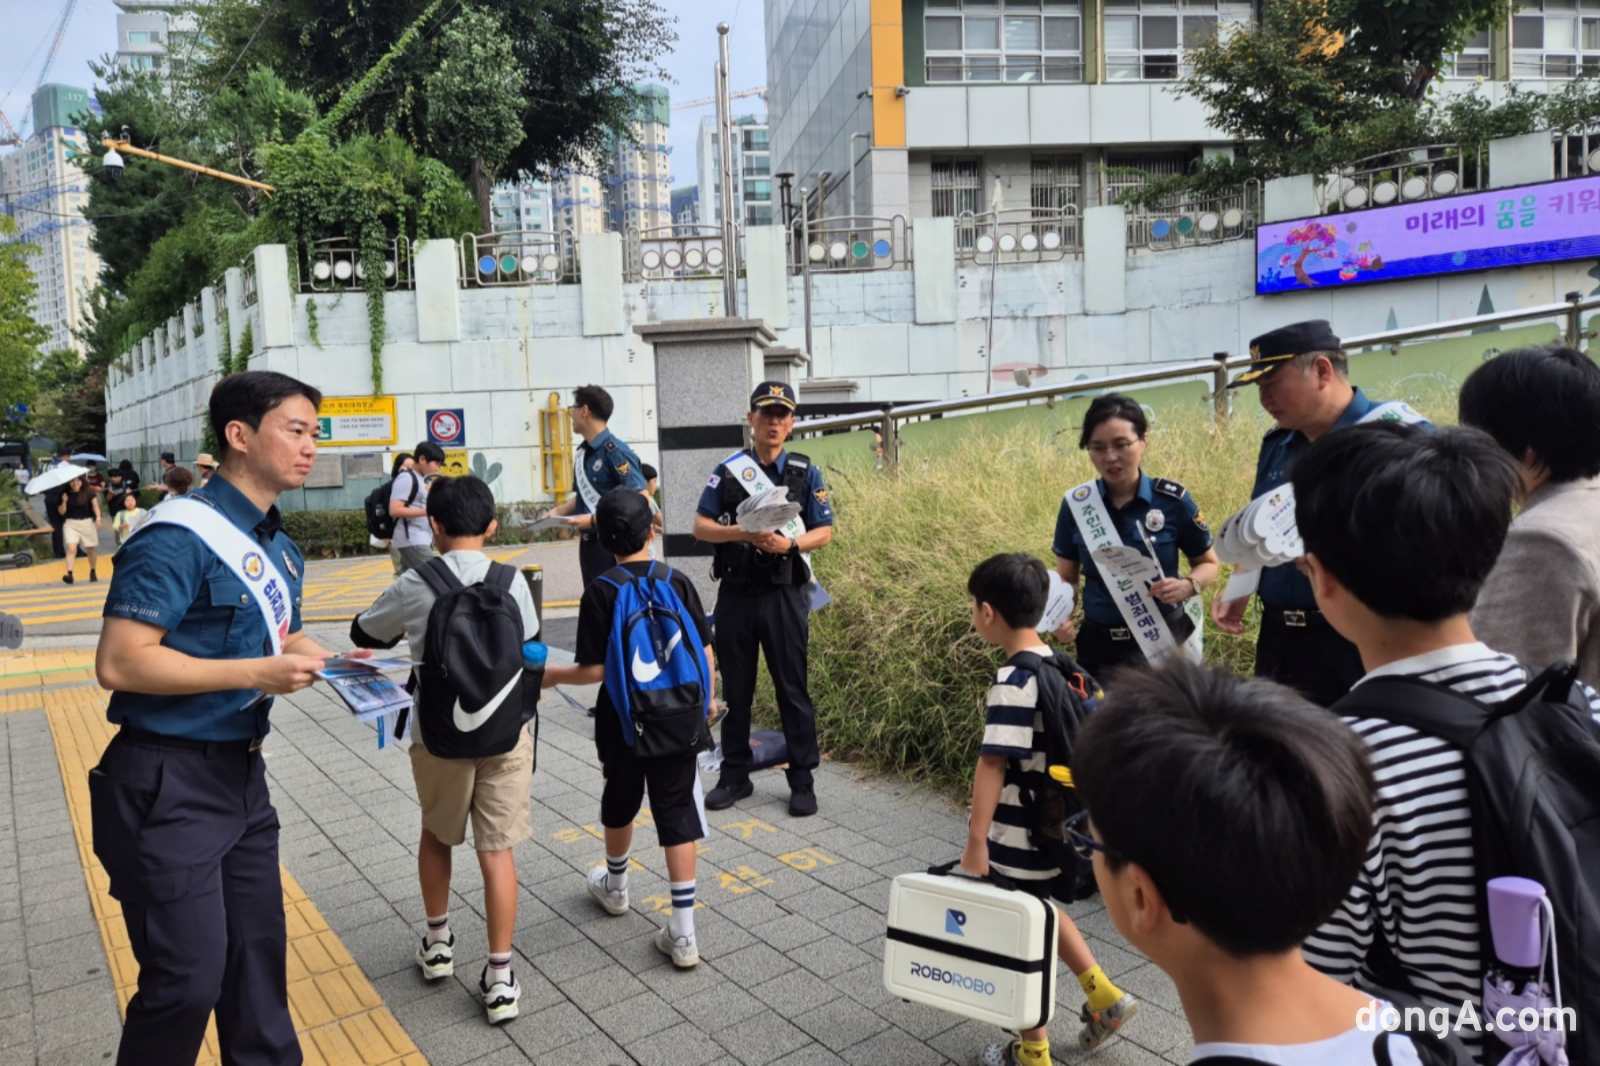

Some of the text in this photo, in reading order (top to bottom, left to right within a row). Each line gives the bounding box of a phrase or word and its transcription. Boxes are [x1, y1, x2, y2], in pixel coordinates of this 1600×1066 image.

[1405, 204, 1485, 234] 미래의
[1495, 194, 1538, 231] 꿈을
[1082, 504, 1107, 540] 주민과
[1124, 590, 1160, 641] 범죄예방
[910, 961, 996, 996] ROBOROBO
